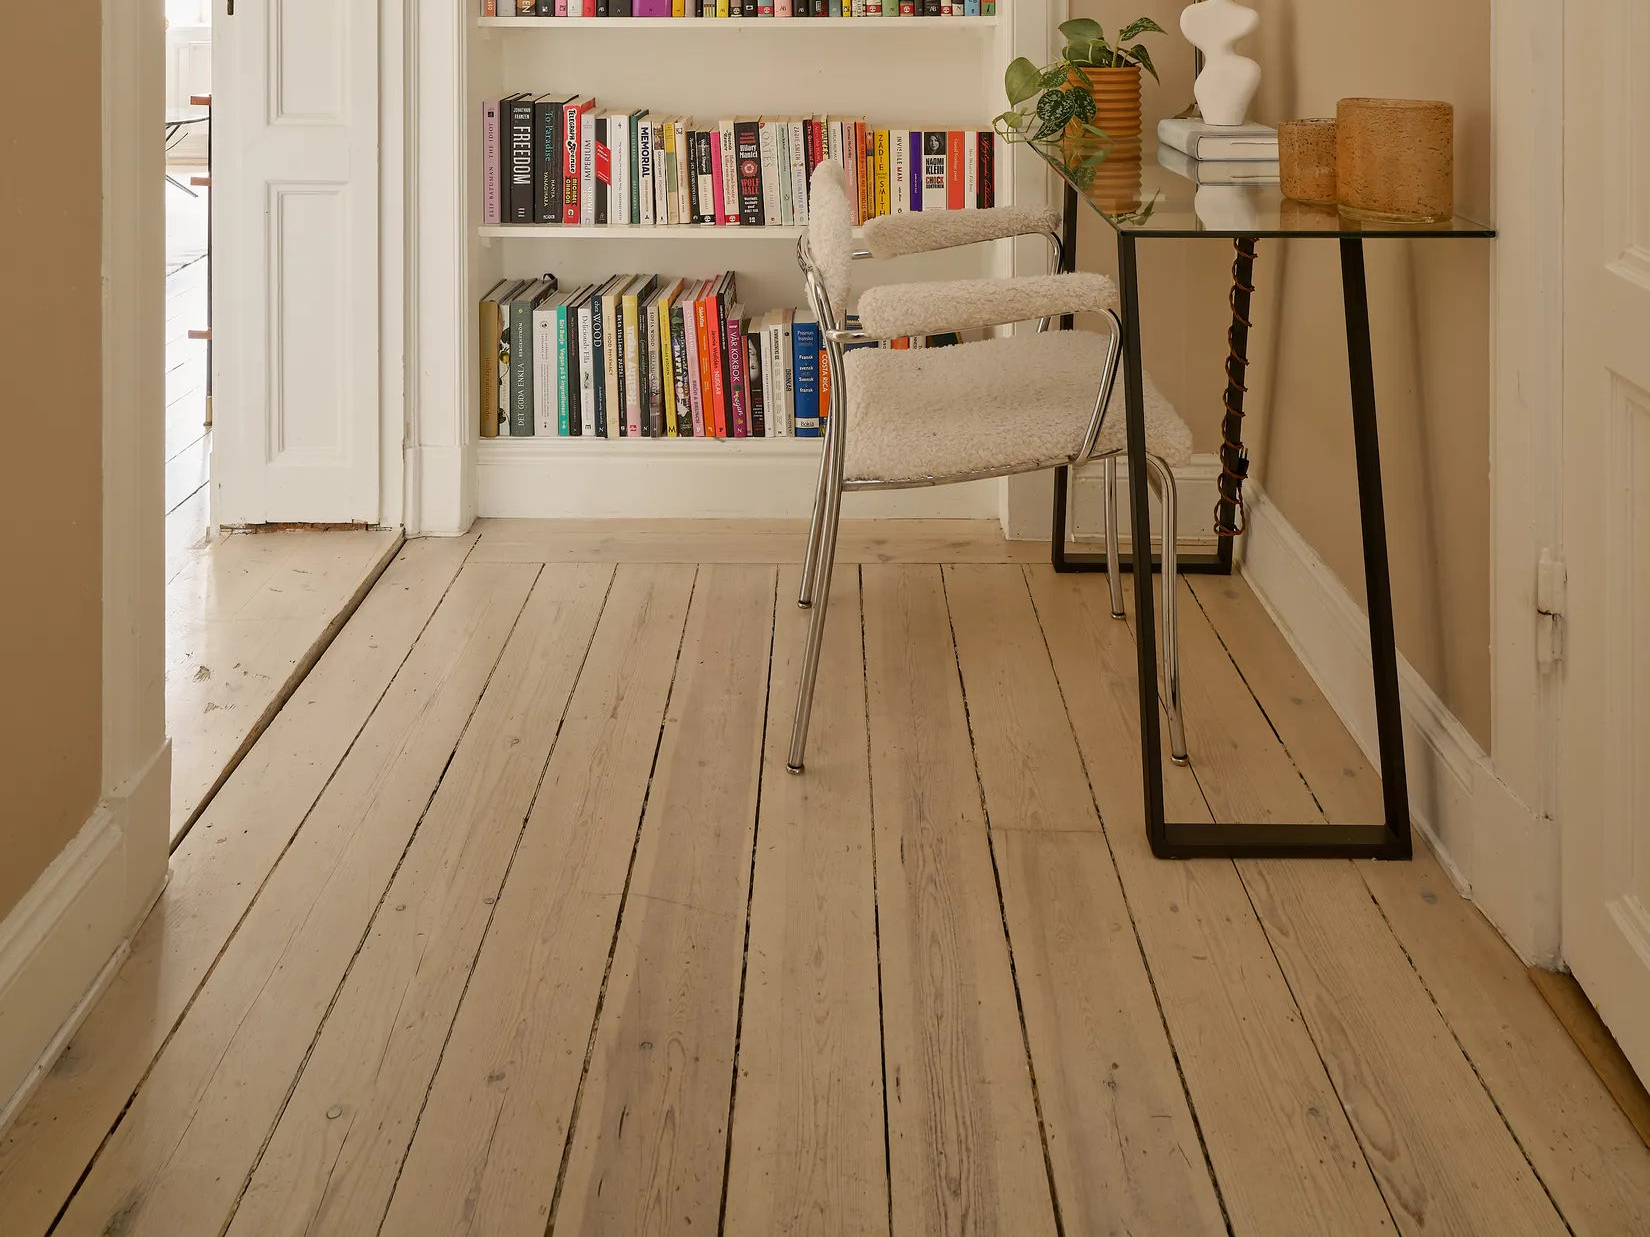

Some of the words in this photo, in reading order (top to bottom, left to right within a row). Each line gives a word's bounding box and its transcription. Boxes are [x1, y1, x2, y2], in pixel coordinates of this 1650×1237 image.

[545, 111, 553, 123] To
[568, 108, 576, 140] TELEGRAPH
[513, 125, 530, 185] FREEDOM
[545, 125, 553, 162] Paradise
[568, 141, 576, 173] Avenue
[641, 127, 650, 178] MEMORIAL
[762, 131, 772, 168] OATES
[925, 157, 944, 165] NAOMI
[925, 165, 944, 175] KLEIN
[741, 179, 760, 187] WOLF
[742, 187, 759, 195] HALL
[925, 176, 944, 184] CHOCK
[581, 315, 589, 350] Deliciously
[593, 313, 602, 347] WOOD
[730, 331, 738, 346] VÅR
[560, 367, 566, 375] på
[731, 347, 740, 382] KOKBOK
[627, 363, 637, 406] Healthy
[733, 394, 743, 416] vegan
